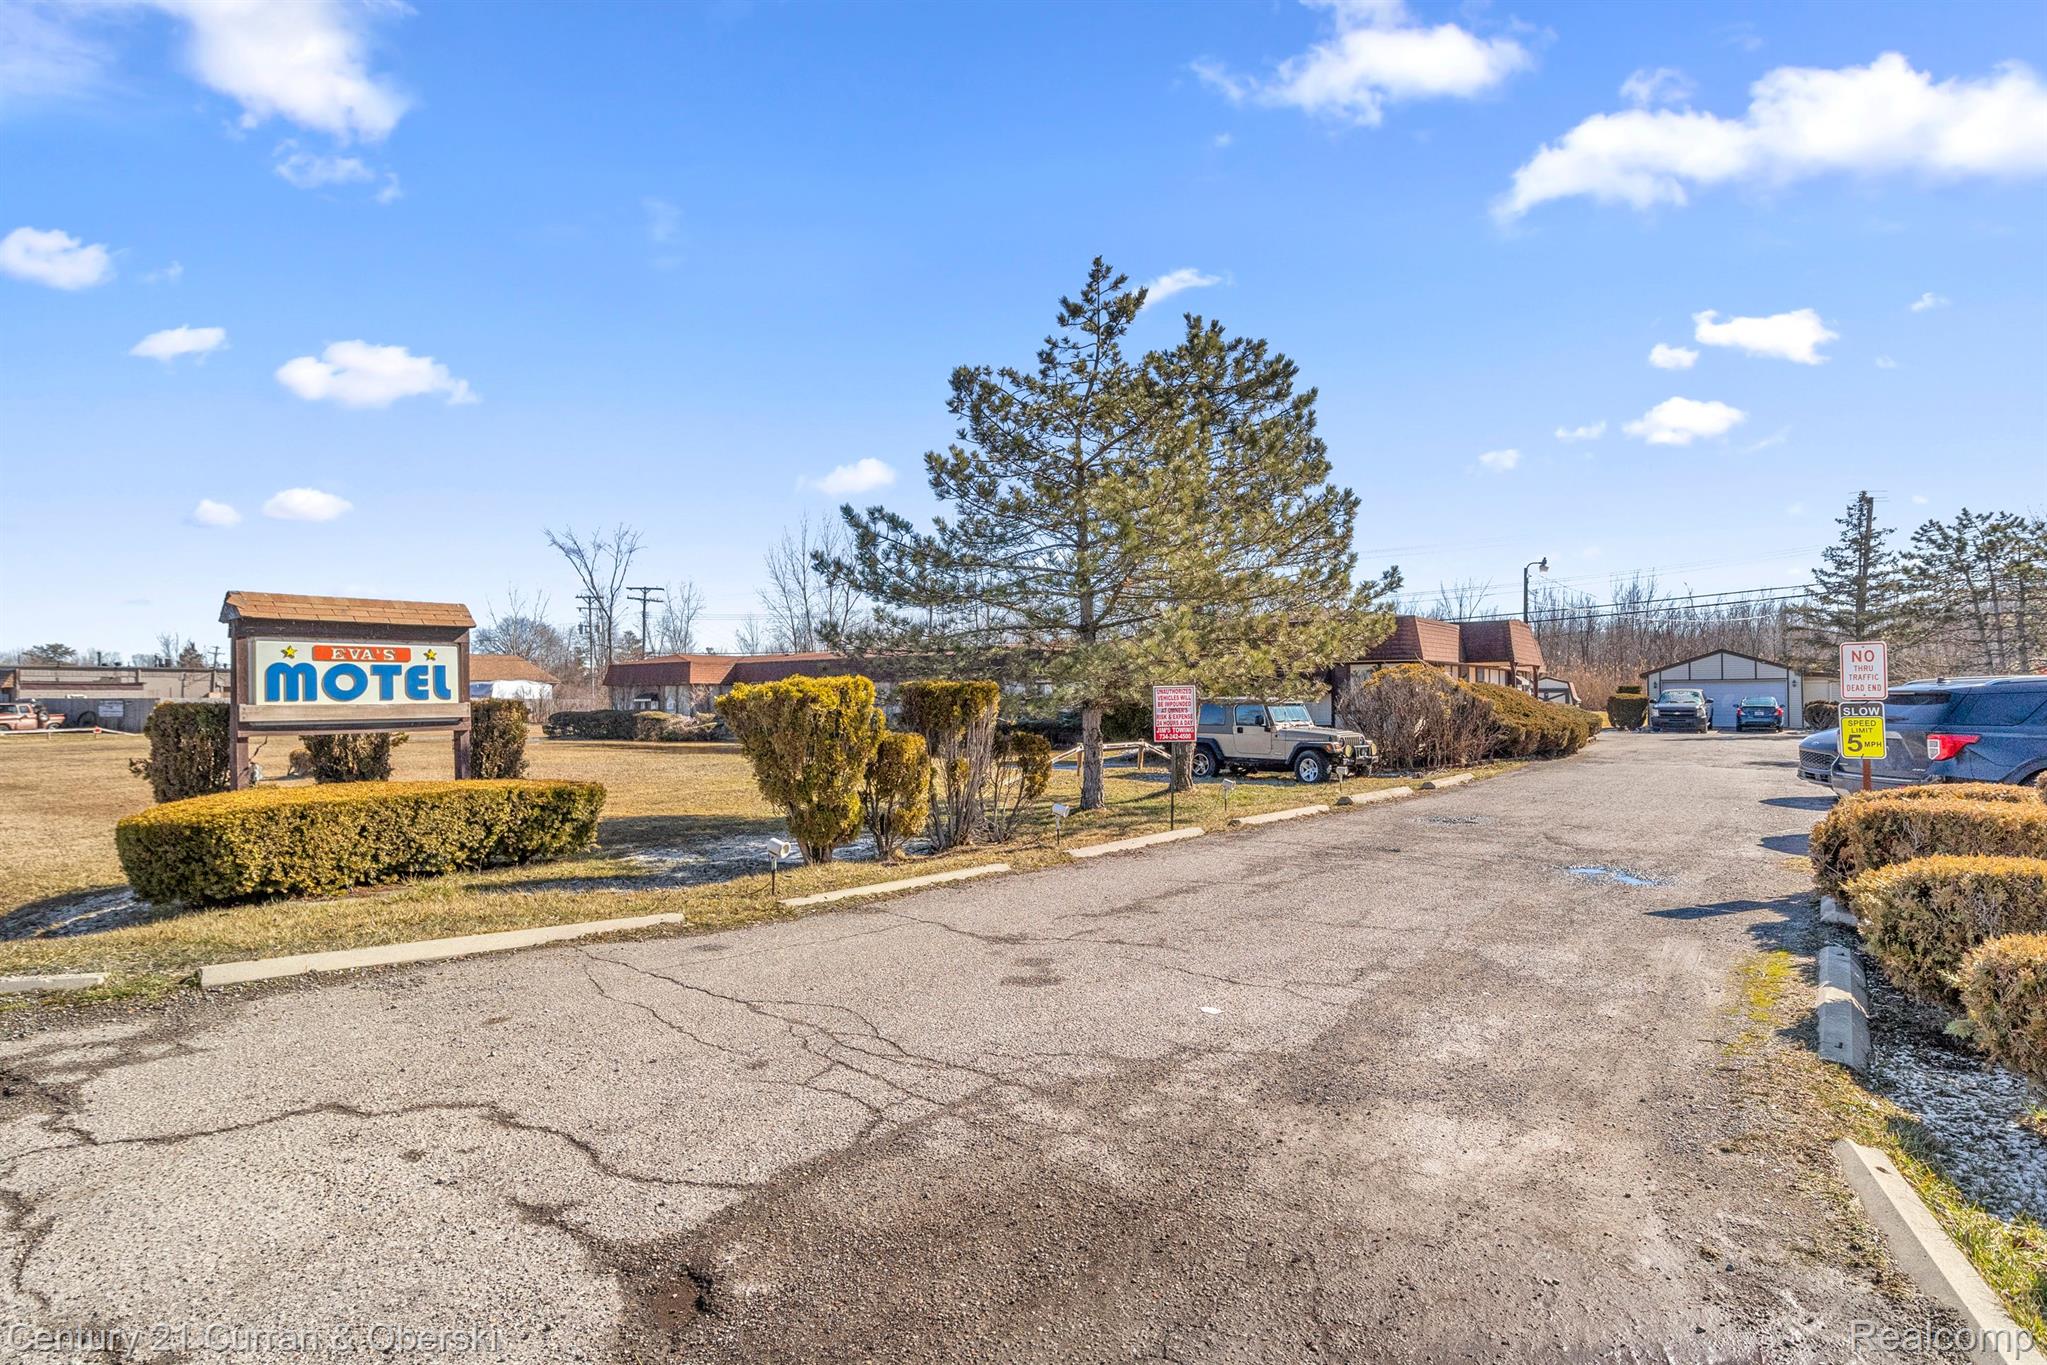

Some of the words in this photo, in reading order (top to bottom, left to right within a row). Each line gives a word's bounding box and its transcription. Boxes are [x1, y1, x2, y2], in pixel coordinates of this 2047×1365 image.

[330, 647, 396, 661] EVA'S
[1851, 650, 1875, 663] NO
[264, 662, 452, 702] MOTEL
[1846, 684, 1865, 692] DEAD
[1867, 684, 1882, 692] END
[1843, 707, 1880, 716] SLOW
[1847, 734, 1863, 752] 5
[1864, 740, 1882, 748] MPH
